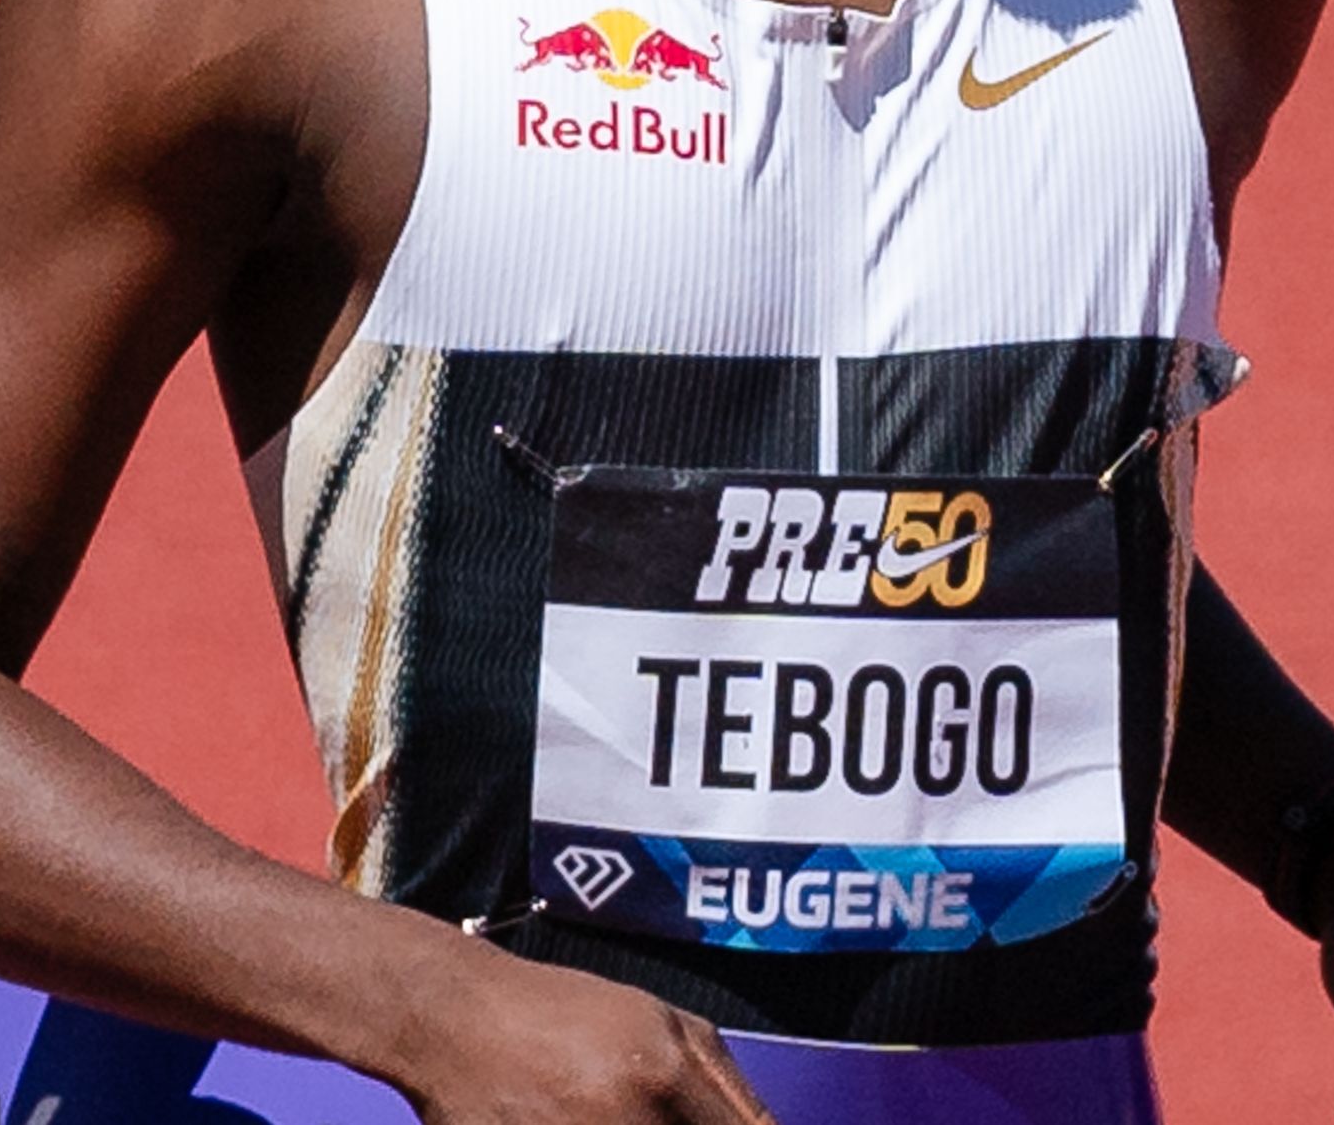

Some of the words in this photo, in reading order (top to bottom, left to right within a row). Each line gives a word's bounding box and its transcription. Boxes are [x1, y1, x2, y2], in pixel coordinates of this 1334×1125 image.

[516, 98, 620, 151] Red
[632, 105, 726, 164] Bull
[636, 656, 1035, 798] TEBOGO
[685, 863, 975, 933] EUGENE
